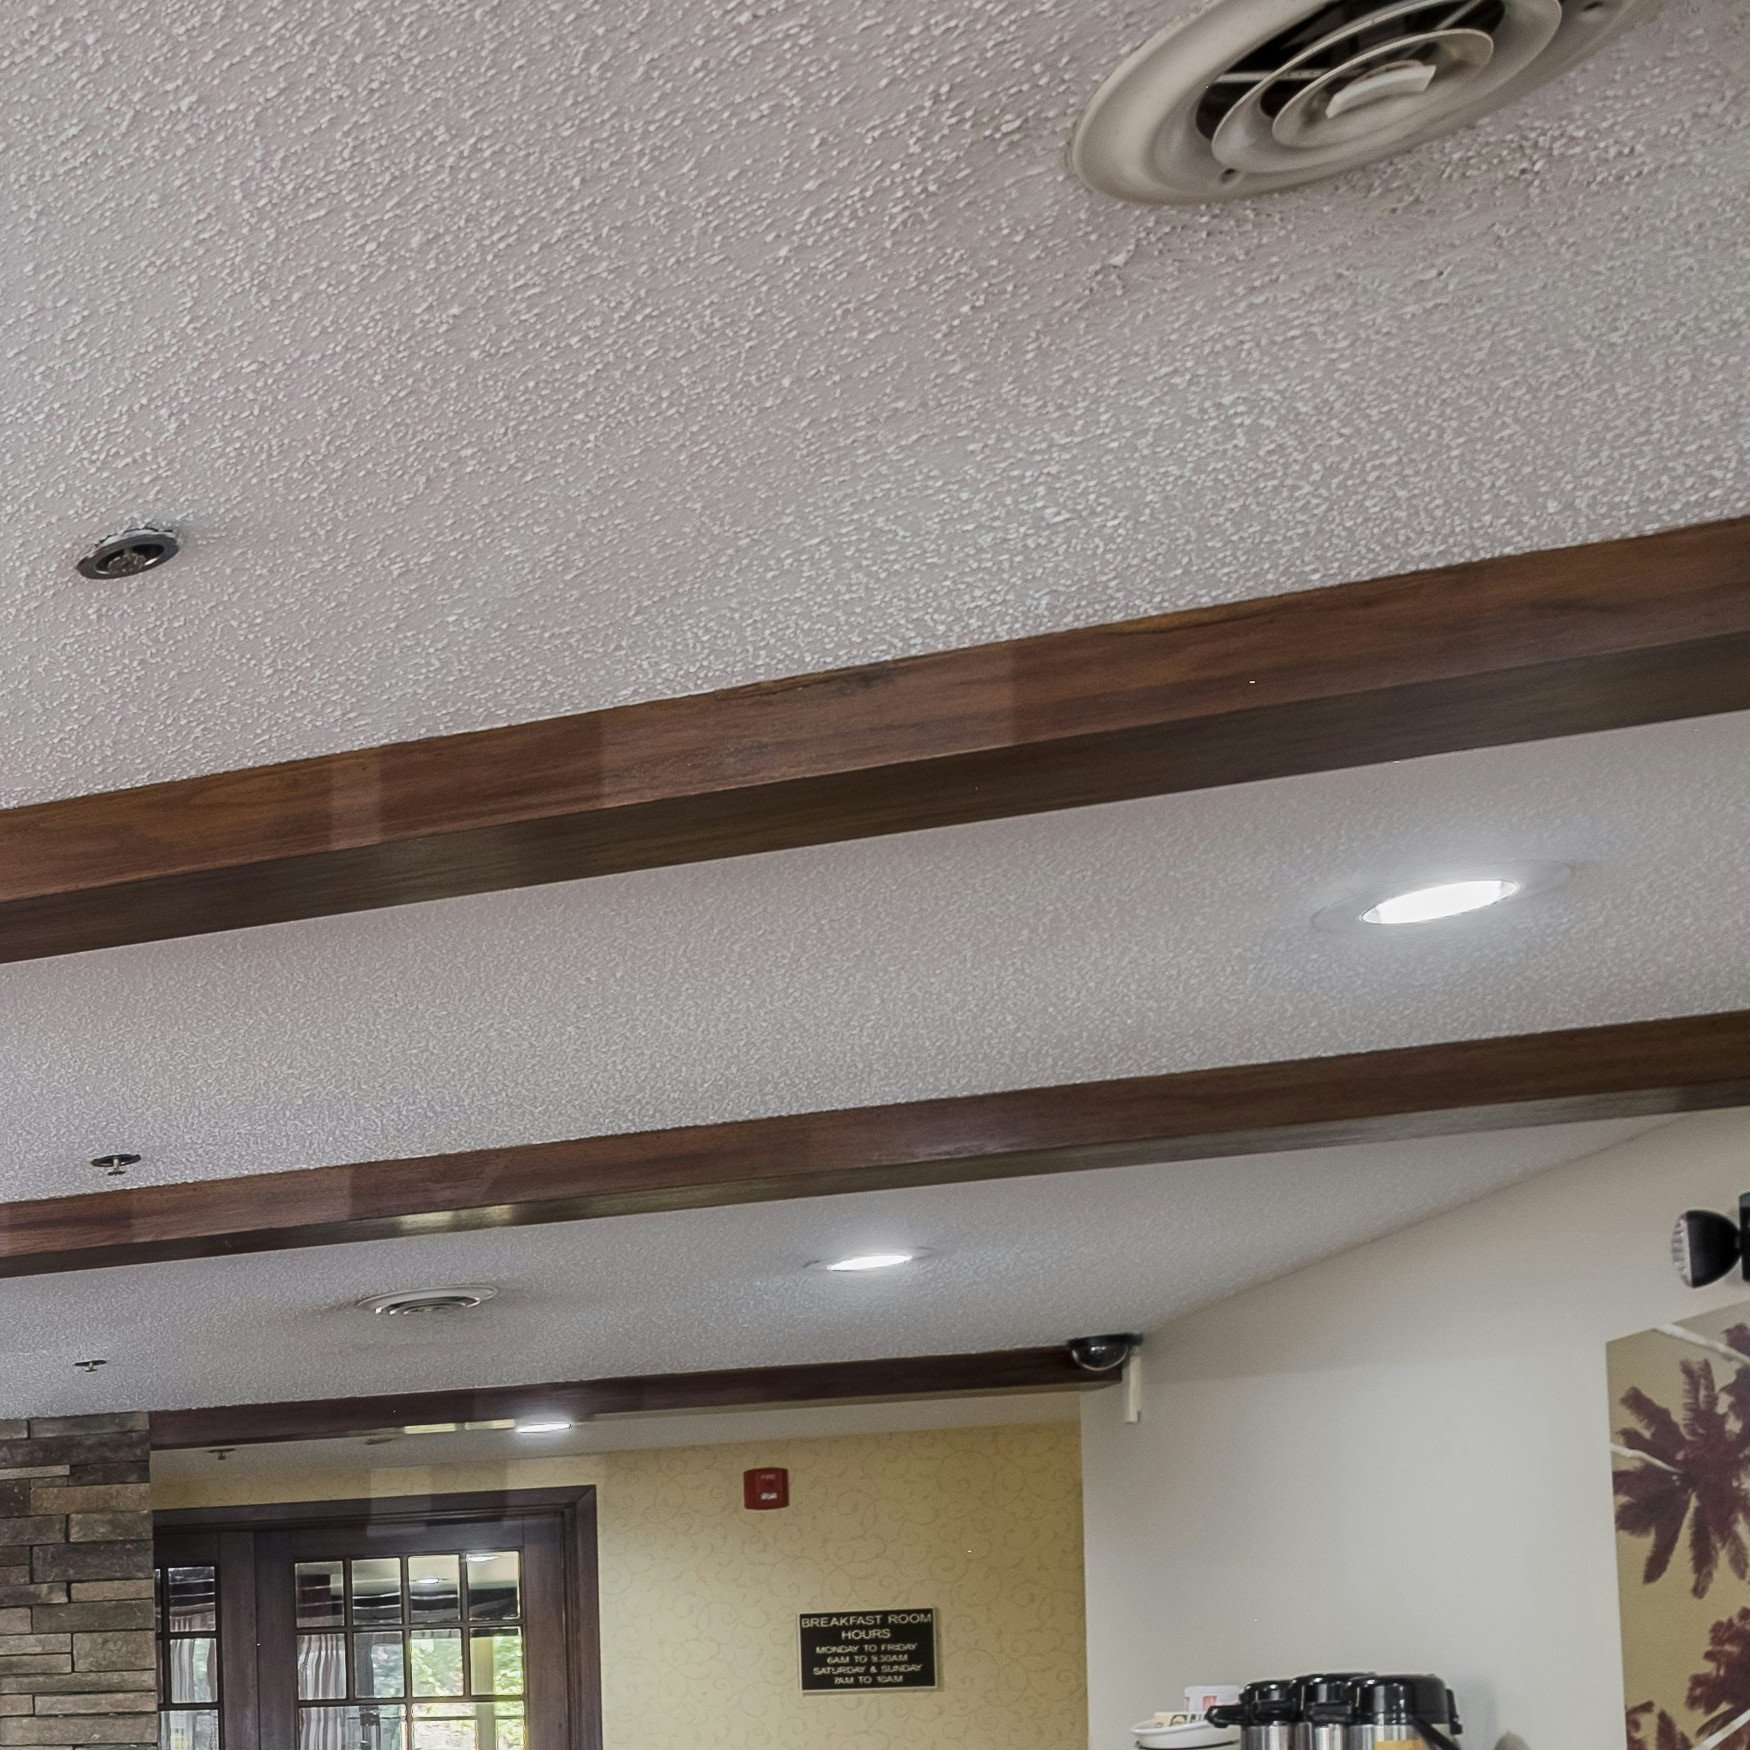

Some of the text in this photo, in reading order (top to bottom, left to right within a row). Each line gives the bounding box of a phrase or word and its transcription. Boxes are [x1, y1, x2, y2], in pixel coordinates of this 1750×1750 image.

[801, 1613, 932, 1628] BREAKFAST ROOM
[841, 1628, 891, 1640] HOURS
[815, 1642, 918, 1654] MONDAY TO FRIDAY
[854, 1655, 868, 1663] TO
[813, 1665, 866, 1675] SATURDAY
[881, 1664, 923, 1673] SUNDAY
[859, 1675, 873, 1684] TO
